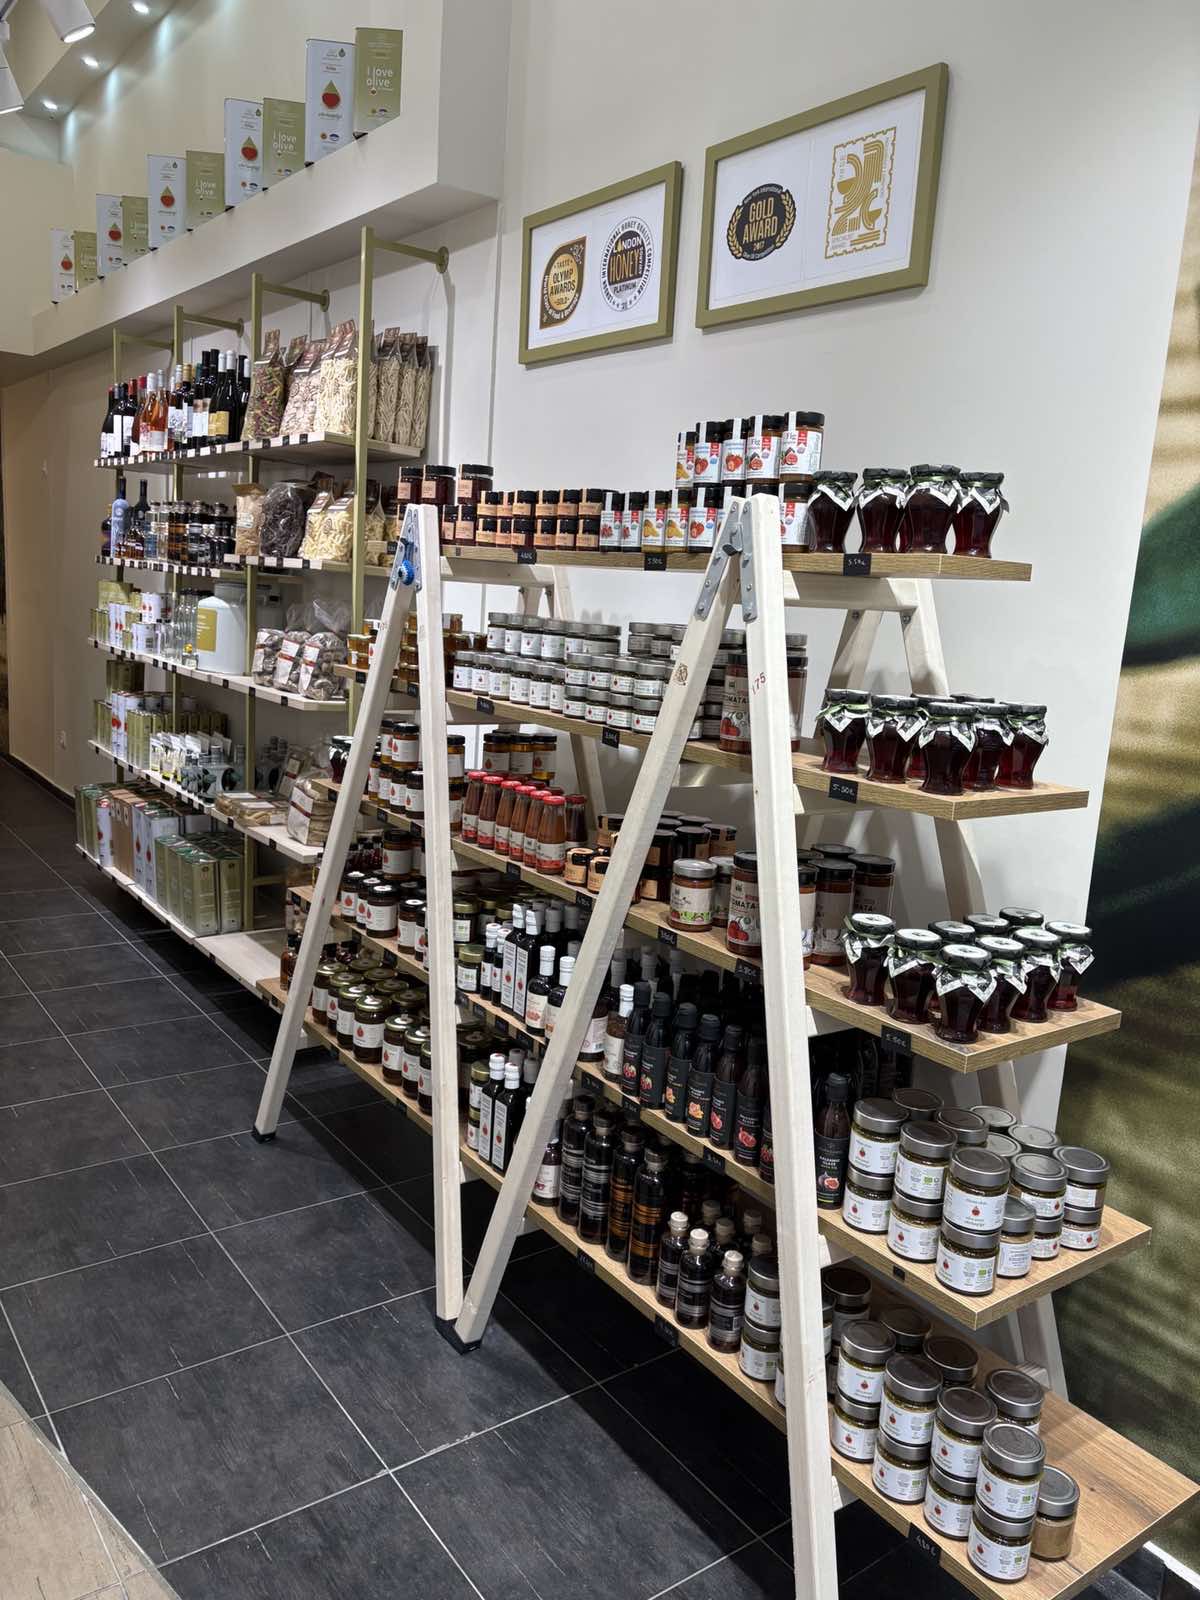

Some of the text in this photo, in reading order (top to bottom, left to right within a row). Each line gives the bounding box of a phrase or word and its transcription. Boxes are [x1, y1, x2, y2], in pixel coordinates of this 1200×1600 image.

[366, 77, 390, 89] olive
[749, 197, 774, 223] GOLD
[743, 216, 778, 244] AWARD
[609, 248, 640, 282] HONEY
[553, 269, 574, 284] OLYMP
[549, 280, 576, 297] AWARDS
[613, 281, 636, 294] PLATINUM
